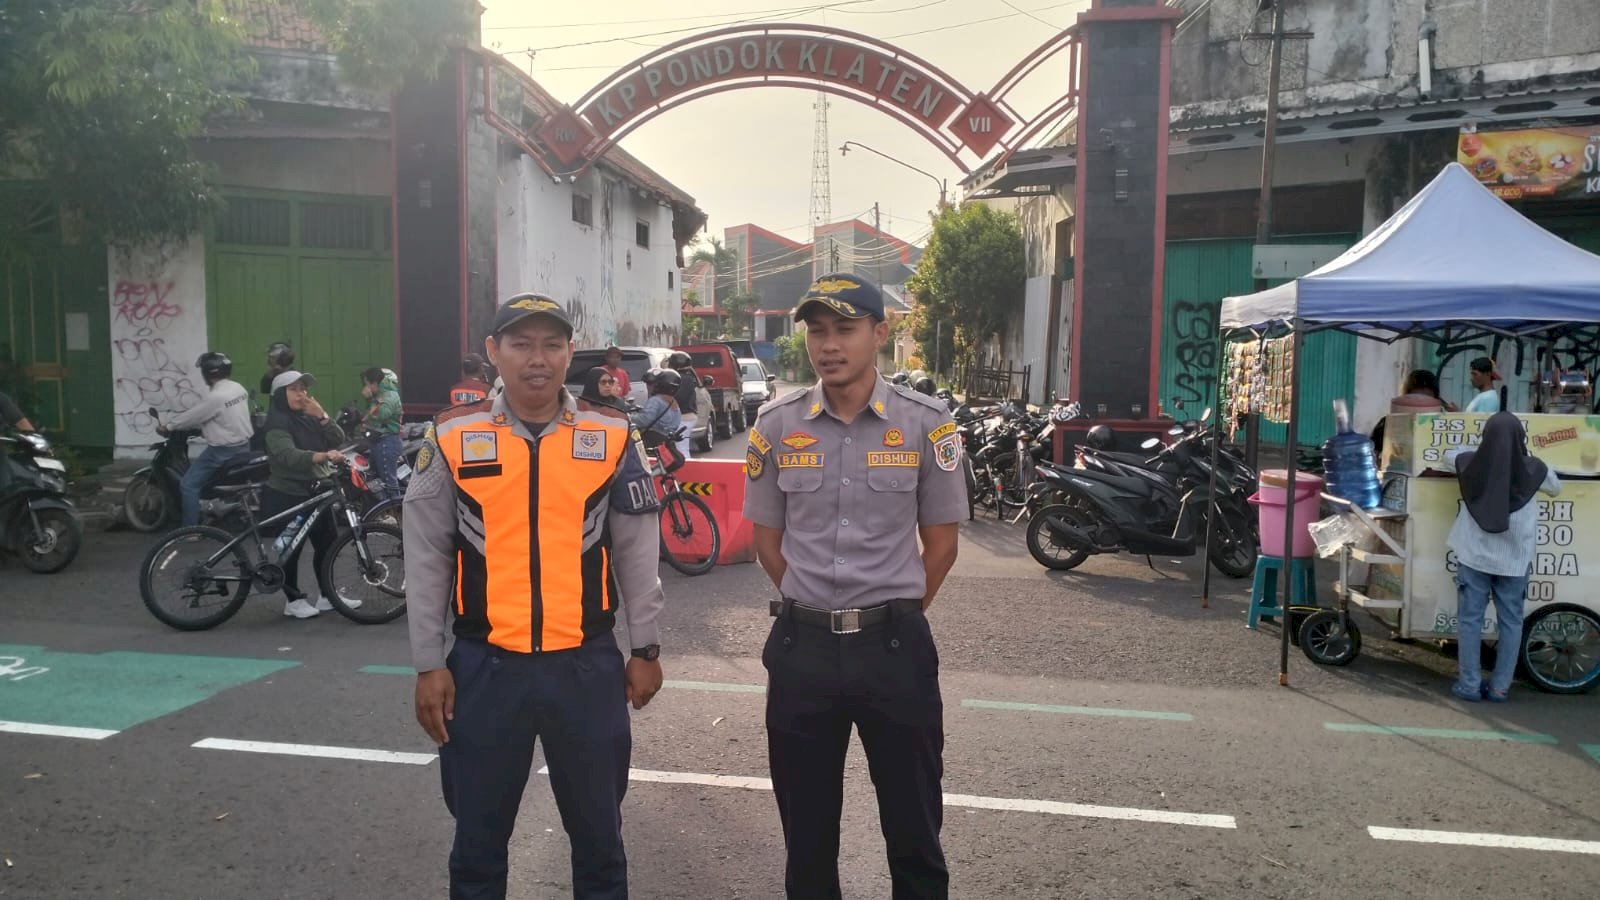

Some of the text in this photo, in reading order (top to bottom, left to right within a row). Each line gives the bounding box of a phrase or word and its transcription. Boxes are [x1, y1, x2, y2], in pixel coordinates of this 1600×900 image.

[597, 39, 943, 126] KP PONDOK KLATEN
[969, 116, 991, 132] VII
[1431, 419, 1465, 431] ES
[871, 454, 916, 464] DISHUB
